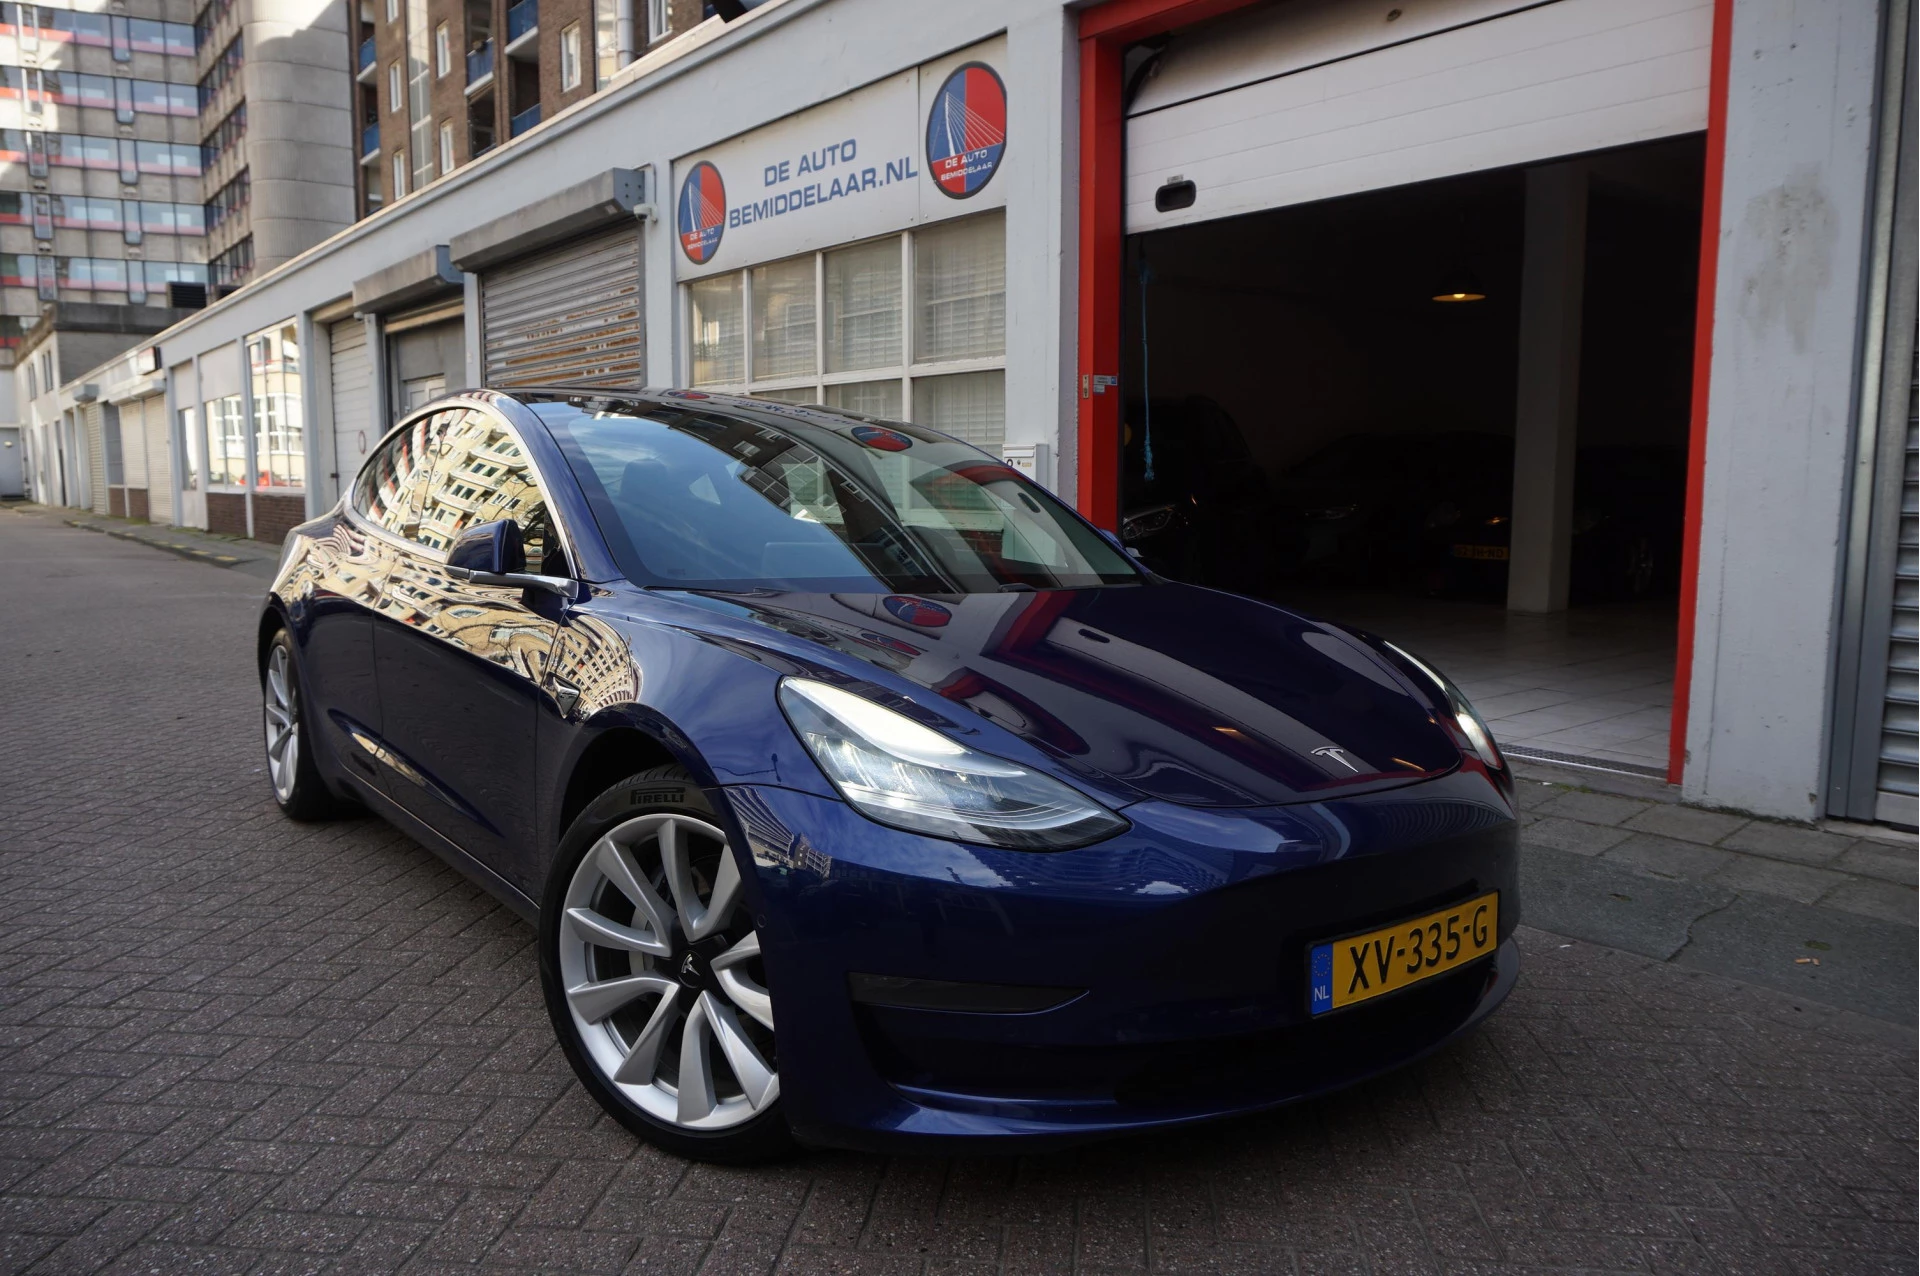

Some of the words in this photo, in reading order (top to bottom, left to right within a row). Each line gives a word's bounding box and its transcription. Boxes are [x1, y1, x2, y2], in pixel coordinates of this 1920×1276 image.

[764, 160, 790, 187] DE
[797, 138, 857, 177] AUTO
[945, 158, 958, 169] DE
[960, 149, 988, 164] AUTO
[941, 162, 993, 180] BEMIDDELAAR
[729, 156, 918, 229] BEMIDDELAAR.NL
[699, 228, 714, 237] AUTO
[630, 787, 686, 805] PIRELLI
[1348, 904, 1488, 994] XV-335-G
[1314, 985, 1330, 1002] NL
